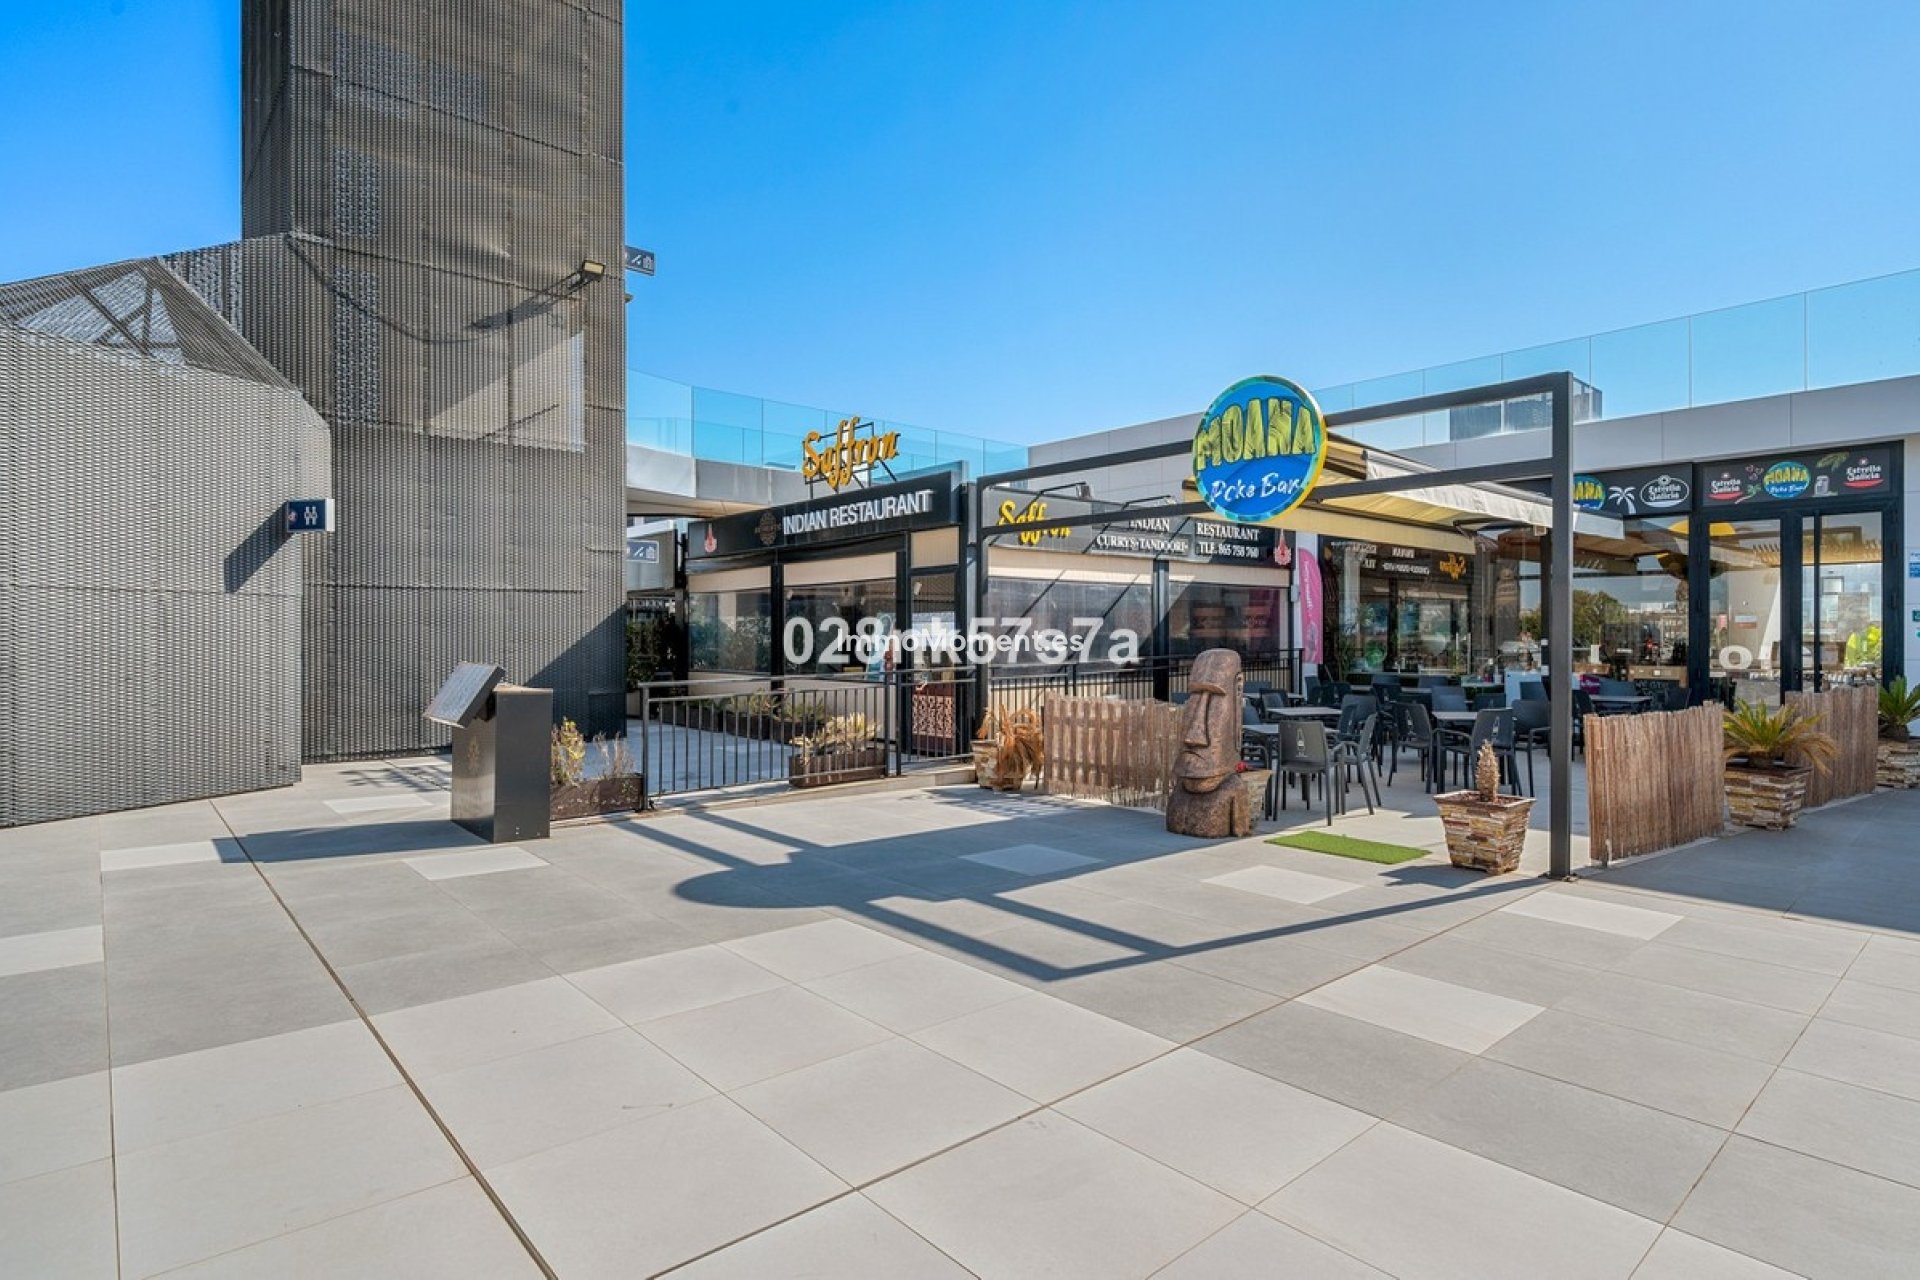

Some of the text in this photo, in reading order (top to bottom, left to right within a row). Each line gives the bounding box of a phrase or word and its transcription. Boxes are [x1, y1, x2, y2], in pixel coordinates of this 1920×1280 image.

[1197, 398, 1316, 471] MOANA
[802, 416, 896, 489] Saffron
[1261, 472, 1301, 497] Bar
[1574, 480, 1602, 501] ANA
[783, 489, 934, 534] INDIAN RESTAURANT
[998, 500, 1072, 545] Saffon
[1129, 517, 1169, 533] INDIAN
[1197, 522, 1259, 541] RESTAURANT
